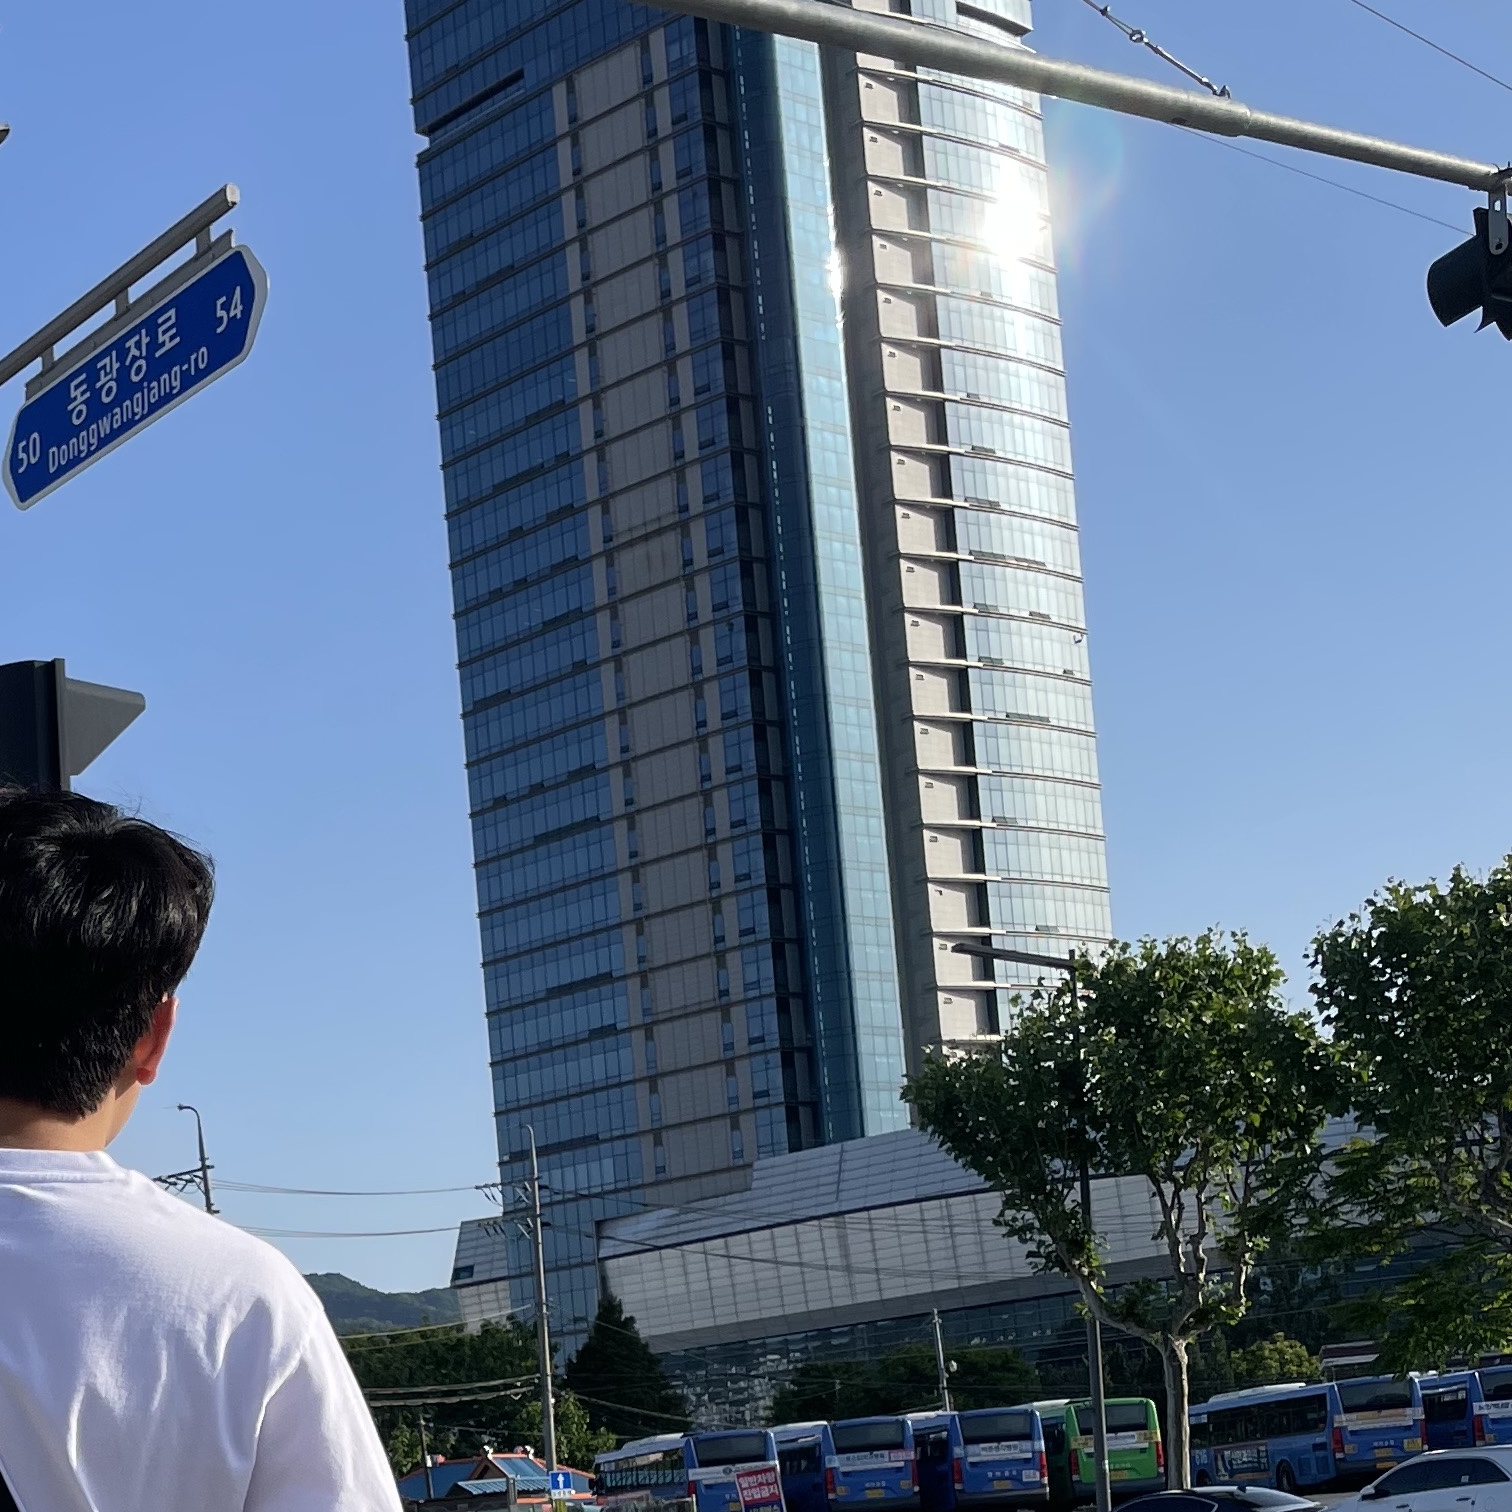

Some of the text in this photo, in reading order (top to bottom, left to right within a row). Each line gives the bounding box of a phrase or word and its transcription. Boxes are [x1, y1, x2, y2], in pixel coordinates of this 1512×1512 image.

[215, 285, 244, 334] 54
[66, 307, 181, 426] 동광장로
[48, 346, 209, 474] Donggwangjang-ro
[17, 431, 41, 474] 50
